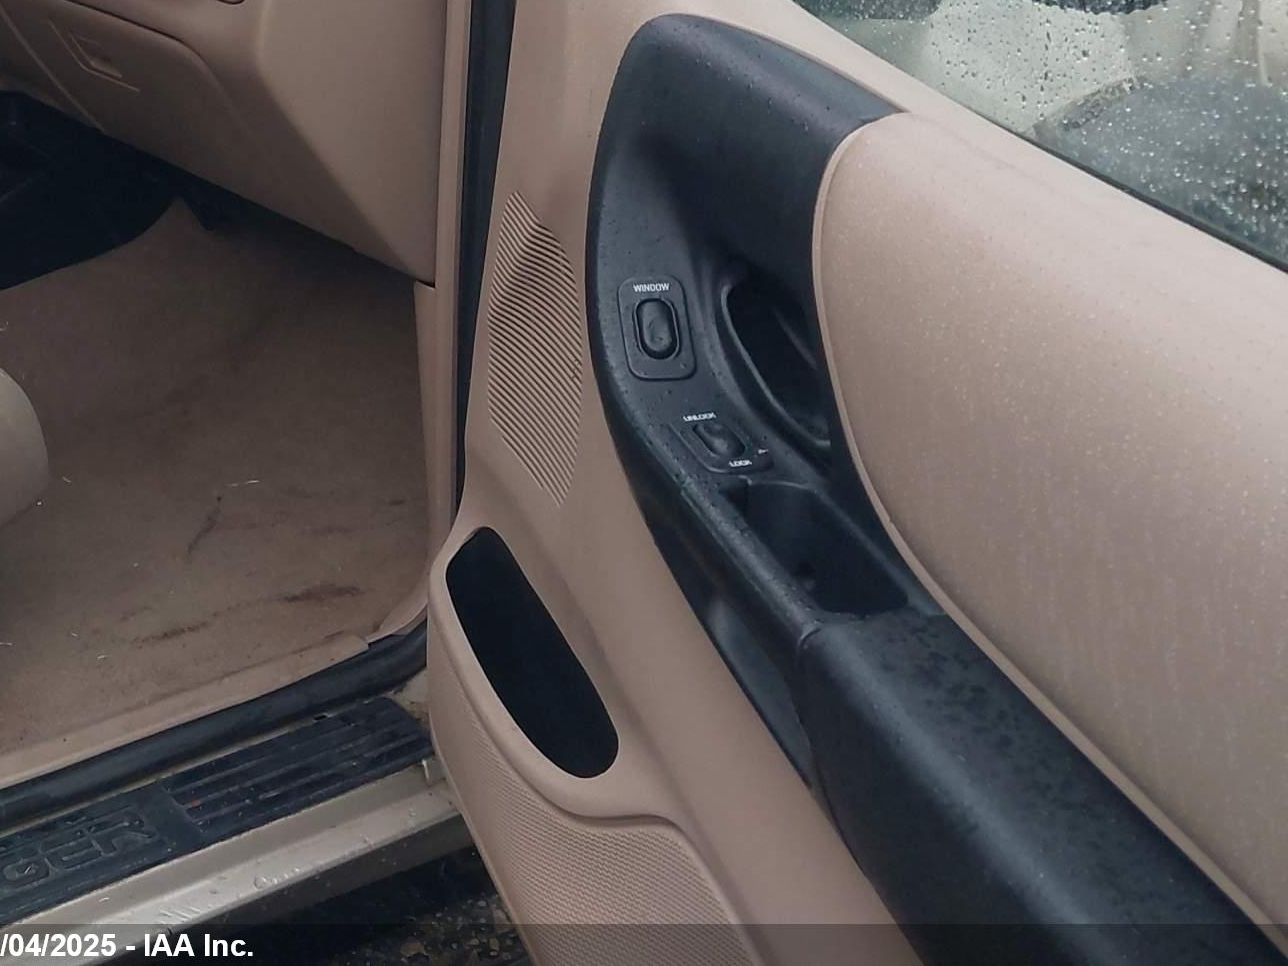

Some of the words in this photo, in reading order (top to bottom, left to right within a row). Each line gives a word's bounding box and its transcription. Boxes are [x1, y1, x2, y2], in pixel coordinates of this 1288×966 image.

[633, 282, 670, 293] WINDOW
[683, 411, 717, 422] UNLOCK
[728, 459, 753, 468] LOCK
